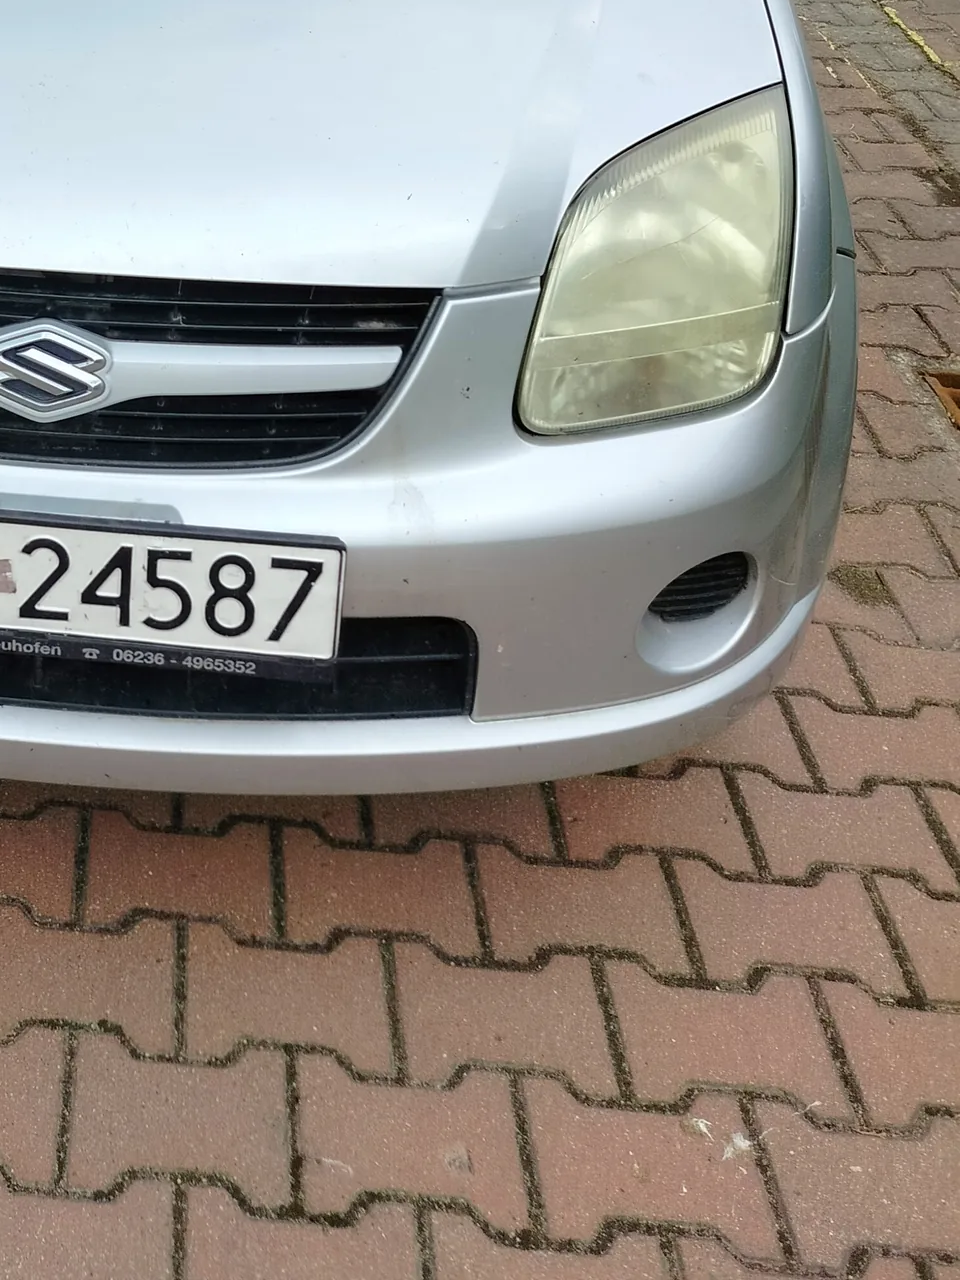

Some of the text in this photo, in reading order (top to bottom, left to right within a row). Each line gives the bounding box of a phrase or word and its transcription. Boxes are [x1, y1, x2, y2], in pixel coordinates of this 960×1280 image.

[19, 537, 324, 642] 24587
[112, 648, 165, 665] 06236
[182, 656, 256, 675] 4965352
